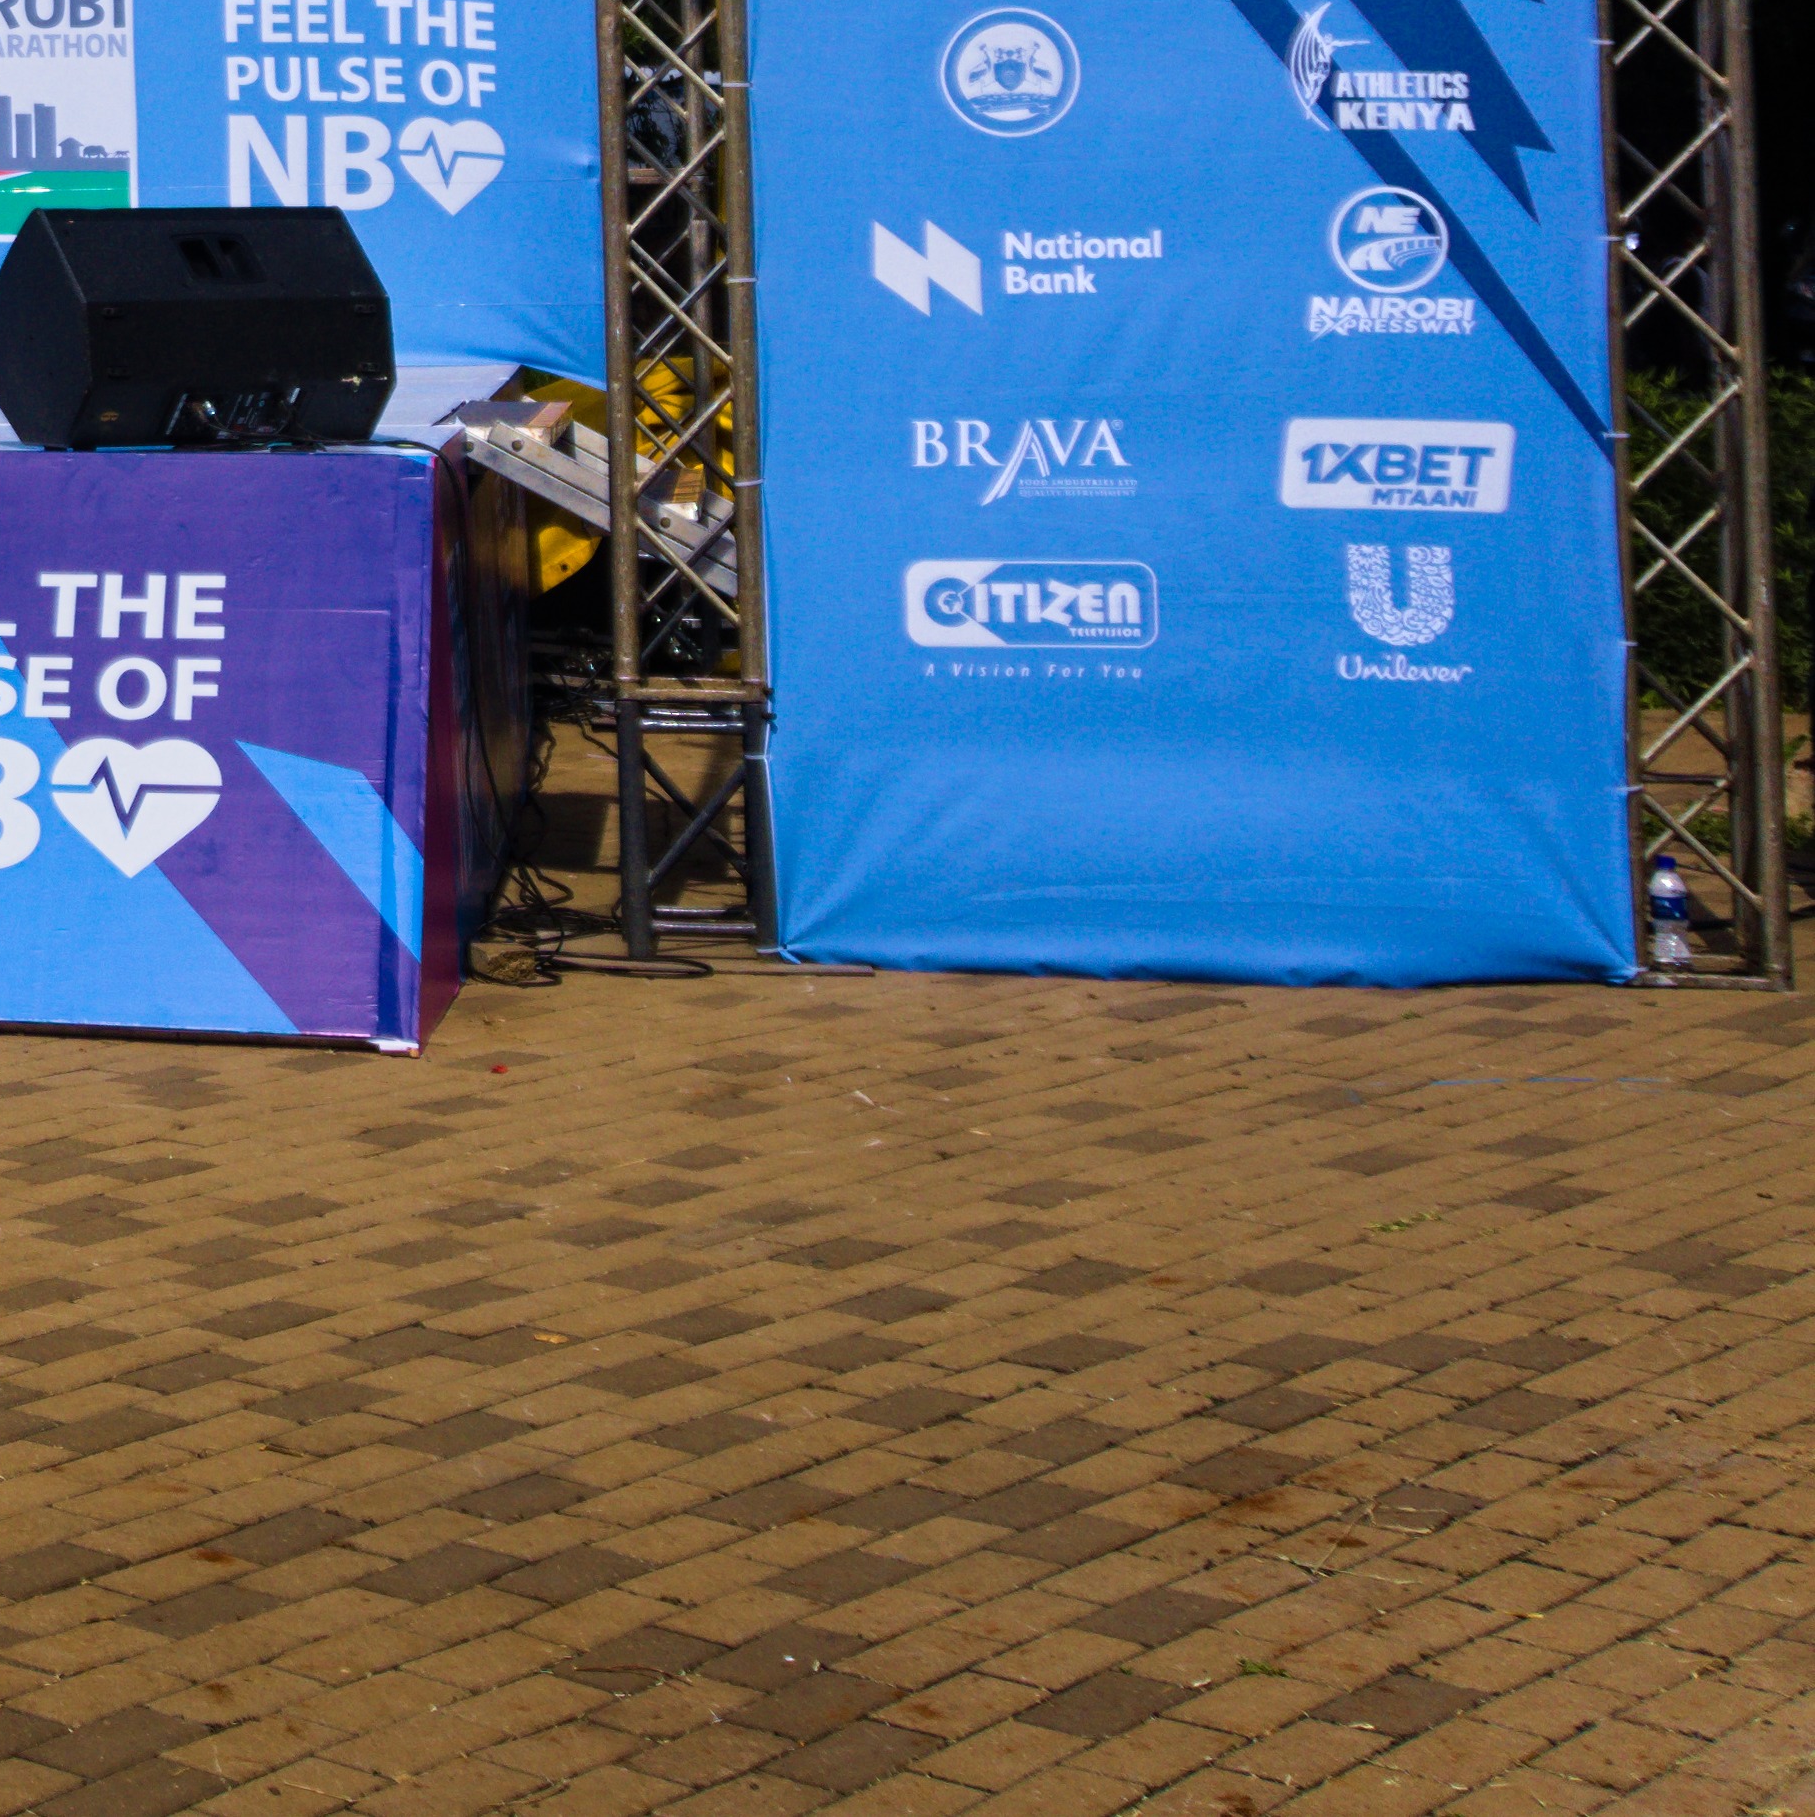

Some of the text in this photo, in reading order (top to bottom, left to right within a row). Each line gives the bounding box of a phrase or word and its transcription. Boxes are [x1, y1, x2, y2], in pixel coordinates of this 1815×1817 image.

[226, 56, 496, 108] PULSE OF
[1335, 72, 1469, 98] ATHLETICS
[1338, 102, 1476, 131] KENYA
[1005, 230, 1162, 260] National
[1005, 265, 1097, 294] Bank
[1310, 296, 1476, 321] NAIROBI
[1309, 317, 1475, 340] EXPRESSWAY
[1301, 443, 1495, 487] 1XBET
[1372, 488, 1478, 508] MTAANI
[39, 573, 226, 640] THE
[1069, 627, 1141, 638] TELEVISION
[926, 663, 1142, 678] A Vision For You
[1338, 654, 1472, 682] Unilever
[98, 657, 221, 721] OF
